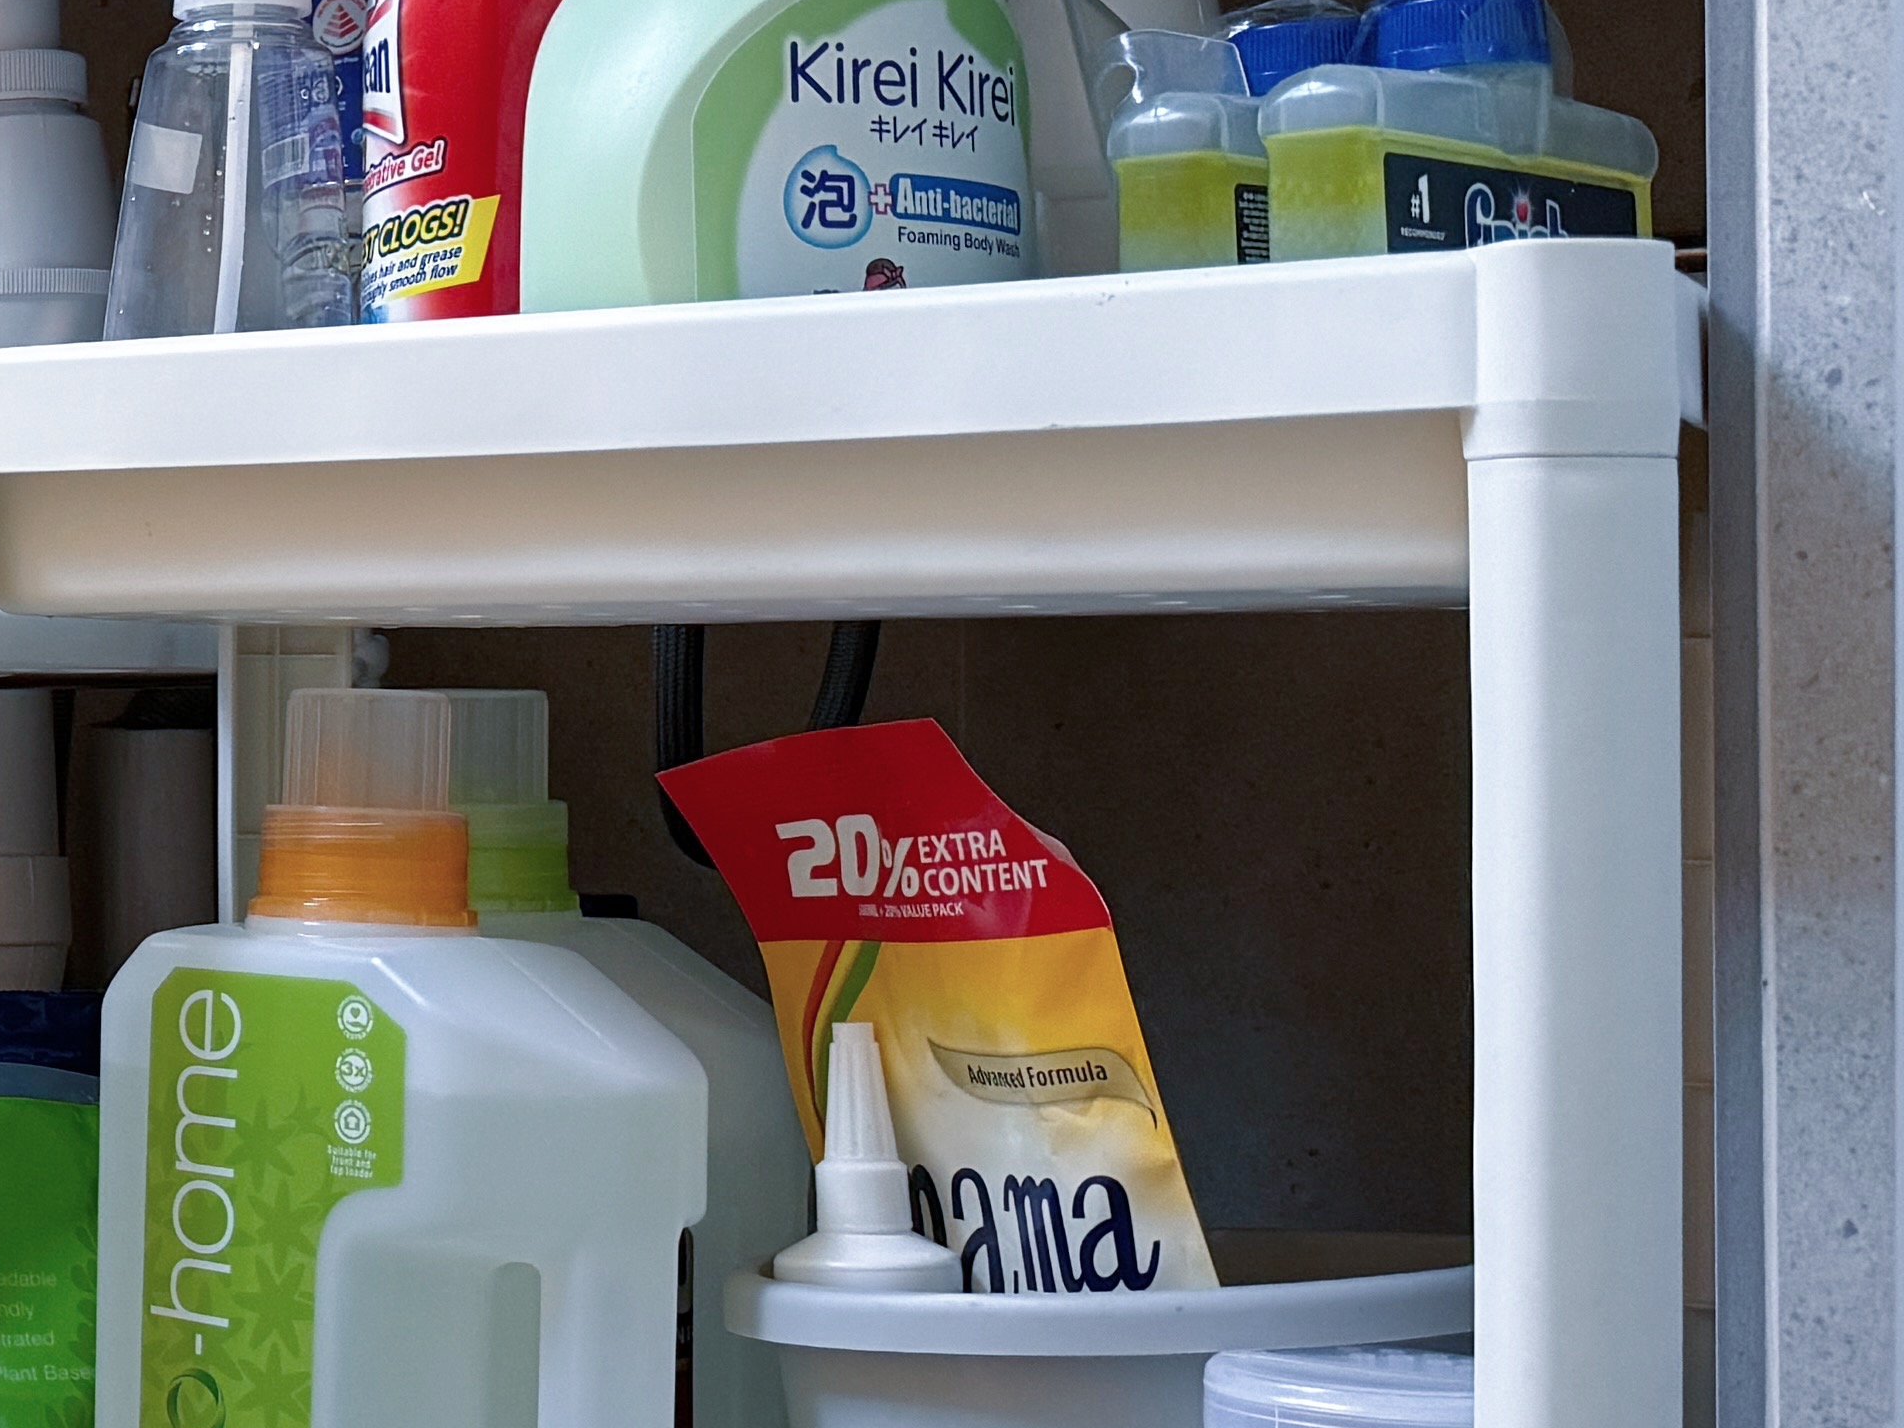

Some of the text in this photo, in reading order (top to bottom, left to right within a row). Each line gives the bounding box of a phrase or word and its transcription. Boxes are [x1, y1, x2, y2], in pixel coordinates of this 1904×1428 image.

[790, 41, 1015, 126] Kirei Kirei
[411, 143, 442, 171] Gel
[800, 170, 858, 229] 泡
[896, 177, 1018, 230] Anti-bacterial
[1410, 174, 1430, 224] #1
[379, 201, 466, 255] CLOGS!
[898, 226, 1020, 258] Foaming Body Wash
[379, 260, 396, 279] hair
[397, 253, 419, 272] and
[420, 246, 462, 270] grease
[388, 270, 427, 292] smooth
[430, 263, 458, 280] flow
[775, 814, 920, 898] 20%
[918, 829, 1007, 864] EXTRA
[923, 859, 1048, 898] CONTENT
[900, 903, 932, 918] VALUE
[932, 901, 965, 917] PACK
[967, 1060, 1108, 1089] Advanced Formula
